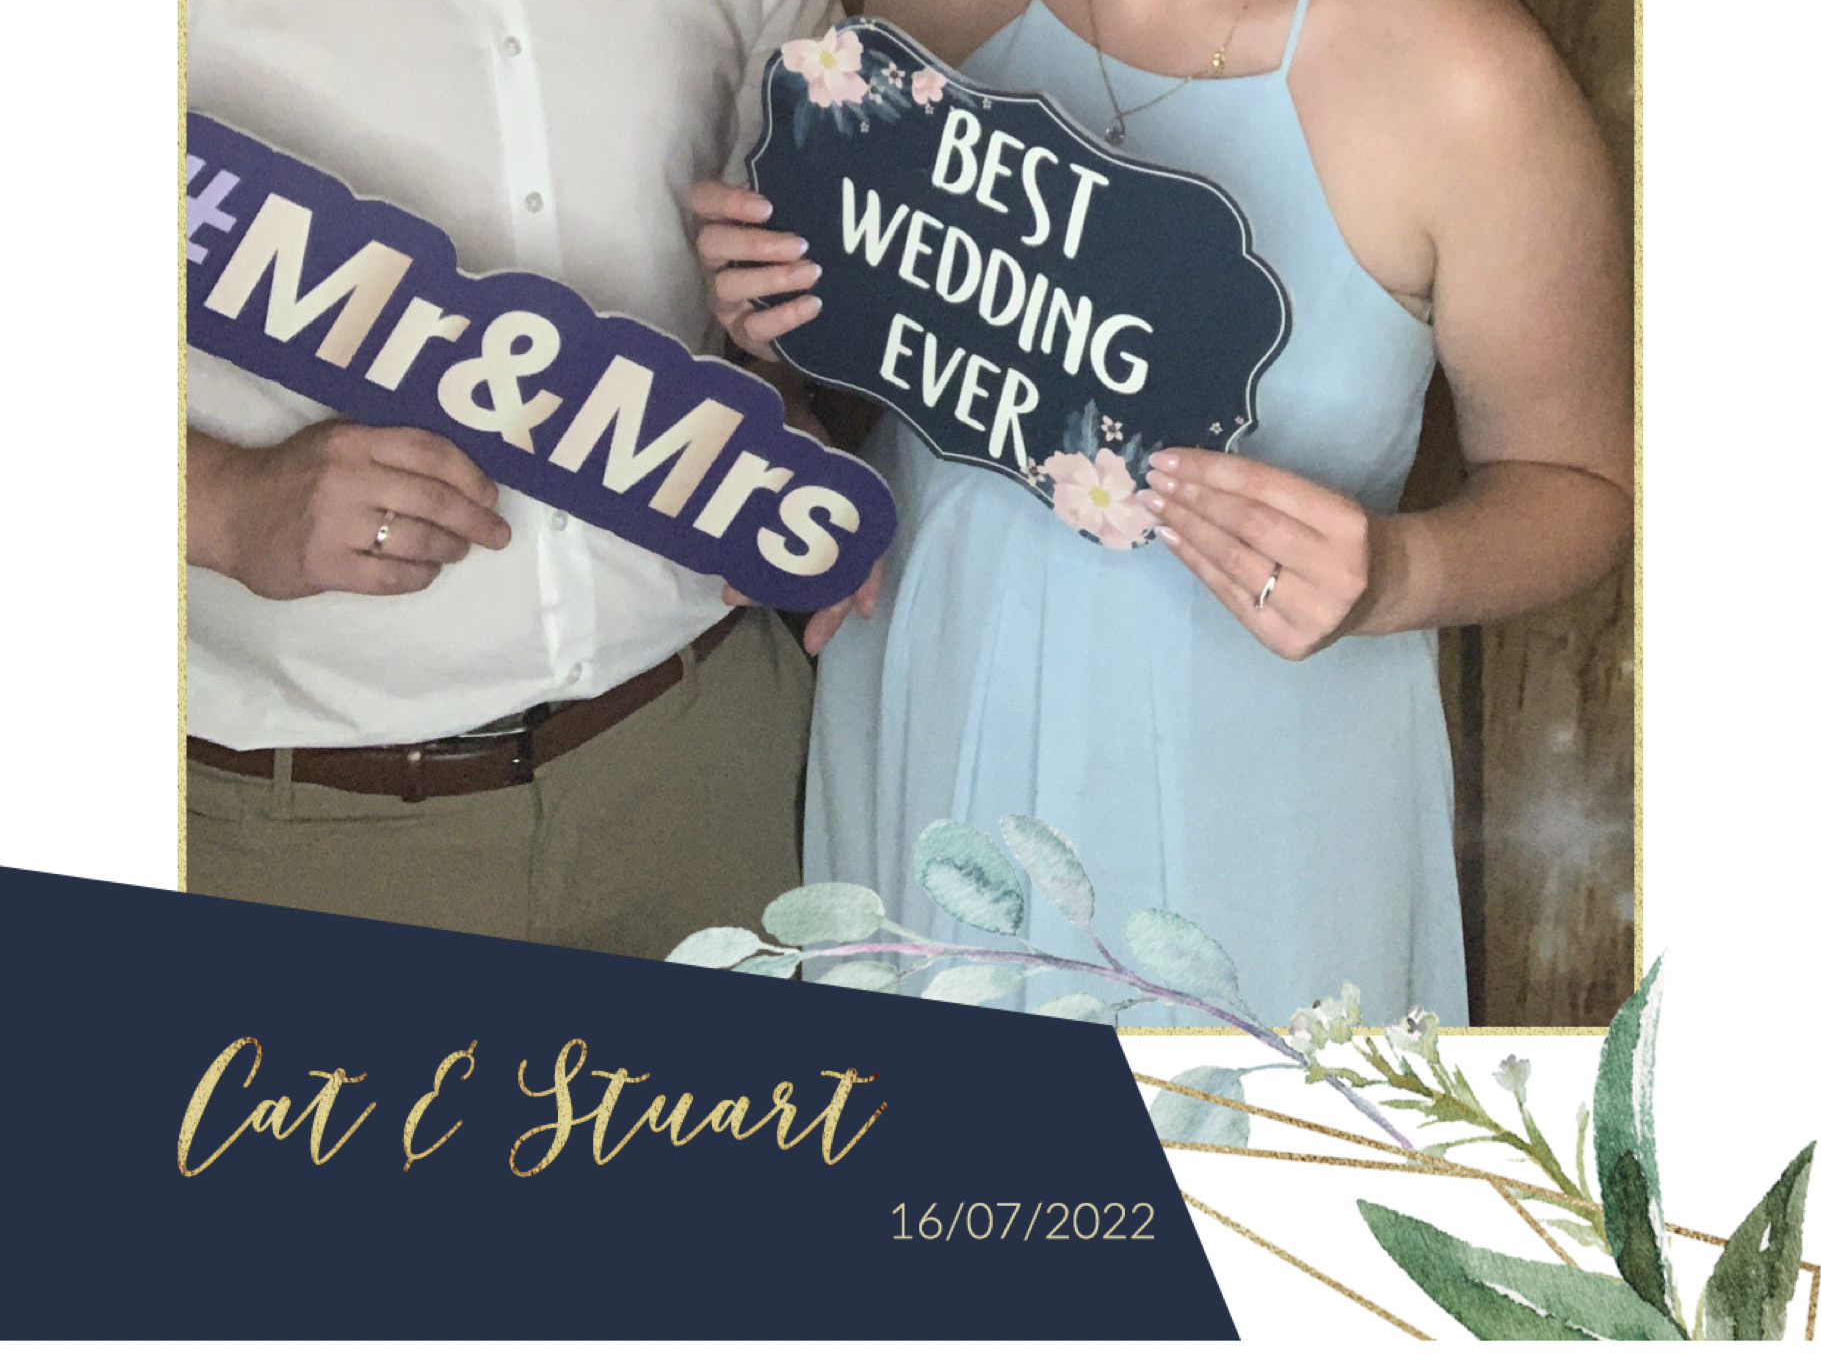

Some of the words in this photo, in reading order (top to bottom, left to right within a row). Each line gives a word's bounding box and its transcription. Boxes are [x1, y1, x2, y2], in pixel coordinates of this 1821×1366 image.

[932, 109, 1109, 259] BEST
[842, 177, 1154, 394] WEDDING
[879, 313, 1040, 466] EVER
